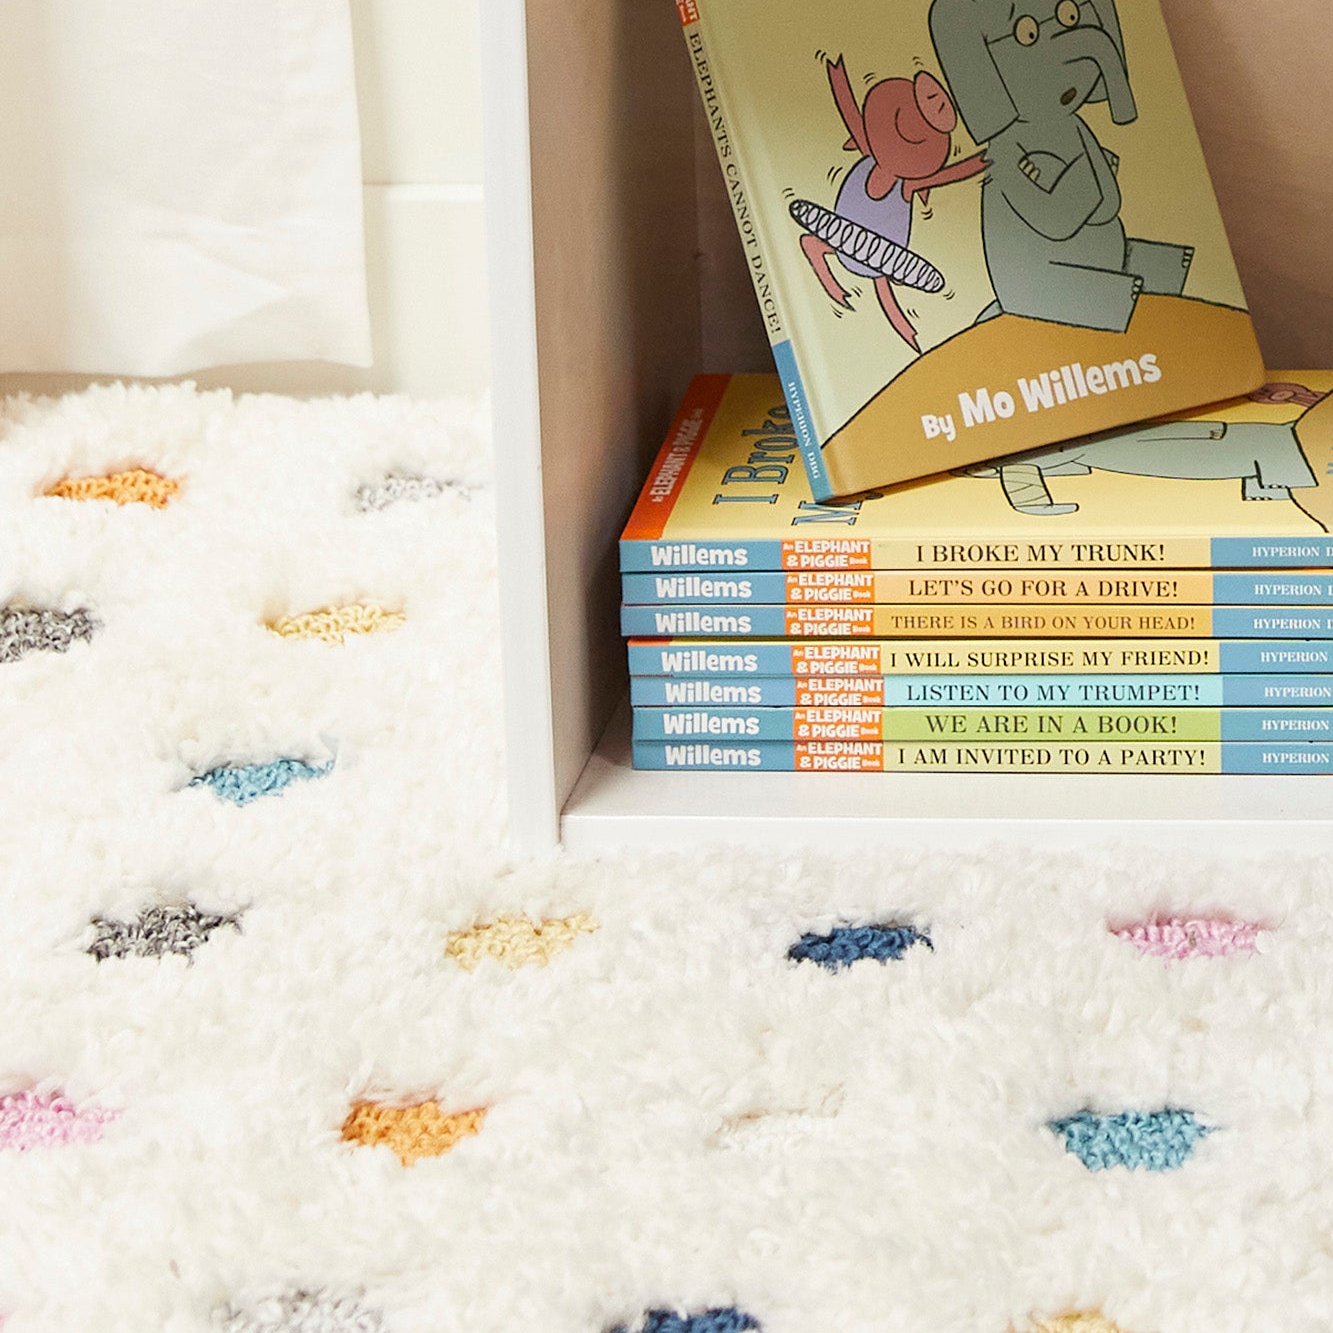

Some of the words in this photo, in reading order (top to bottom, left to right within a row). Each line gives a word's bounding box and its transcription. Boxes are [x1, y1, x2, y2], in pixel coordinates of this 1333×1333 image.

[688, 32, 733, 158] ELEPHANTS
[726, 164, 758, 247] CANNOT
[750, 254, 783, 334] DANCE!
[920, 413, 956, 443] By
[957, 387, 1016, 429] Mo
[1017, 353, 1163, 413] Willems
[650, 544, 748, 566] Willems
[917, 545, 923, 562] I
[933, 544, 1019, 563] BROKE
[1027, 544, 1063, 562] MY
[1071, 544, 1164, 562] TRUNK!
[1252, 546, 1320, 557] HYPERION
[910, 579, 974, 596] LET'S
[981, 580, 1013, 596] GO
[1021, 580, 1066, 597] FOR
[1075, 581, 1089, 597] A
[1099, 580, 1178, 598] DRIVE!
[890, 615, 954, 629] THERE
[960, 615, 978, 629] IS
[983, 616, 995, 629] A
[1001, 616, 1046, 630] BIRD
[1051, 616, 1077, 629] ON
[1082, 616, 1132, 630] YOUR
[1139, 616, 1195, 630] HEAD!
[891, 652, 896, 668] I
[905, 652, 960, 668] WILL
[967, 651, 1074, 668] SURPRISE
[1082, 651, 1112, 667] MY
[1122, 650, 1208, 666] FRIEND!
[907, 684, 990, 701] LISTEN
[997, 684, 1029, 701] TO
[1037, 684, 1070, 701] MY
[1078, 684, 1199, 701] TRUMPET!
[925, 715, 967, 733] WE
[976, 715, 1028, 734] ARE
[1038, 715, 1063, 734] IN
[1072, 715, 1088, 734] A
[1098, 715, 1177, 734] BOOK!
[899, 748, 904, 764] I
[914, 748, 947, 765] AM
[957, 748, 1051, 765] INVITED
[1058, 749, 1090, 765] TO
[1098, 749, 1112, 766] A
[1121, 749, 1205, 766] PARTY!
